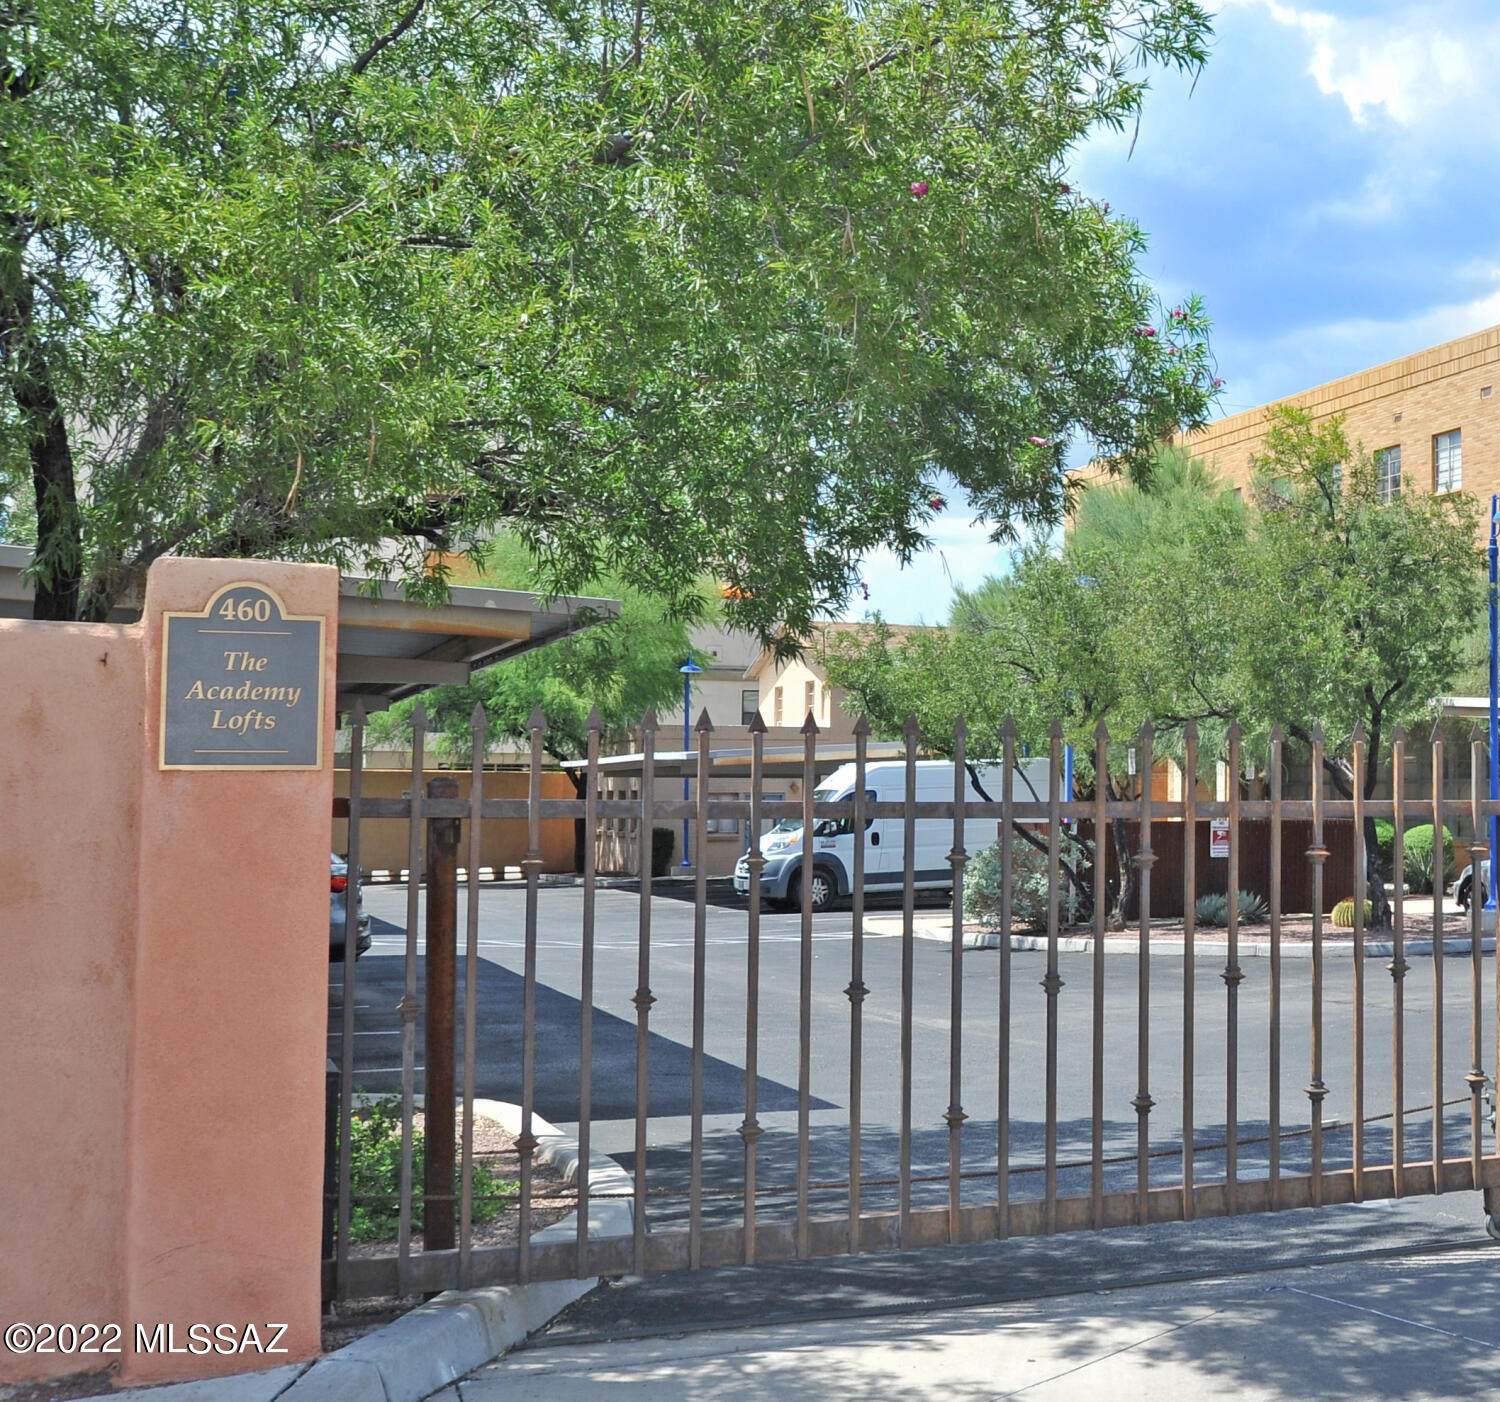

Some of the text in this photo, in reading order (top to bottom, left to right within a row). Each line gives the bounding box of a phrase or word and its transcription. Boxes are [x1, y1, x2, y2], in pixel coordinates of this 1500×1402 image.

[219, 598, 271, 622] 460
[223, 651, 268, 672] The
[184, 680, 302, 708] Academy
[211, 709, 277, 736] Lofts
